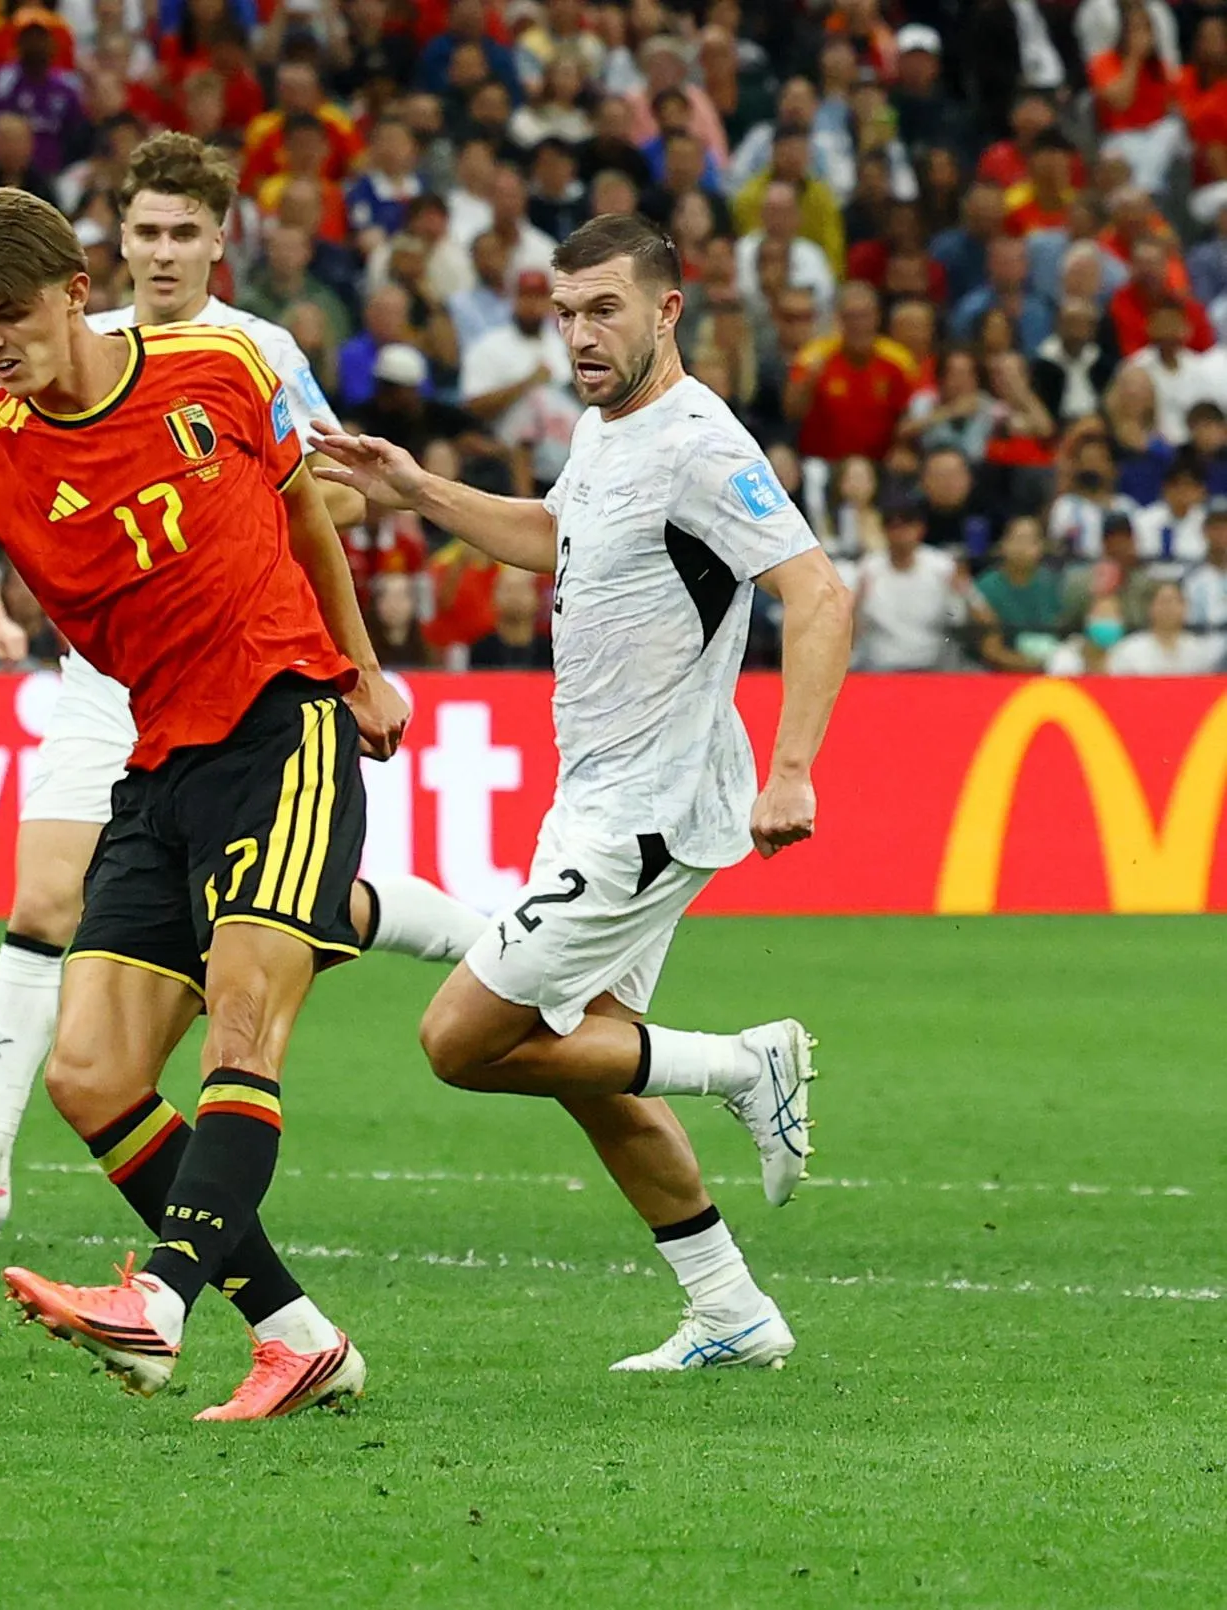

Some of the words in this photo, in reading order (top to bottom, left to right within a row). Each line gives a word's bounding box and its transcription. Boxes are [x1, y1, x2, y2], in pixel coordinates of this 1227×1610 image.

[113, 482, 188, 570] 17
[514, 868, 588, 934] 2
[165, 1204, 224, 1230] RBFA
